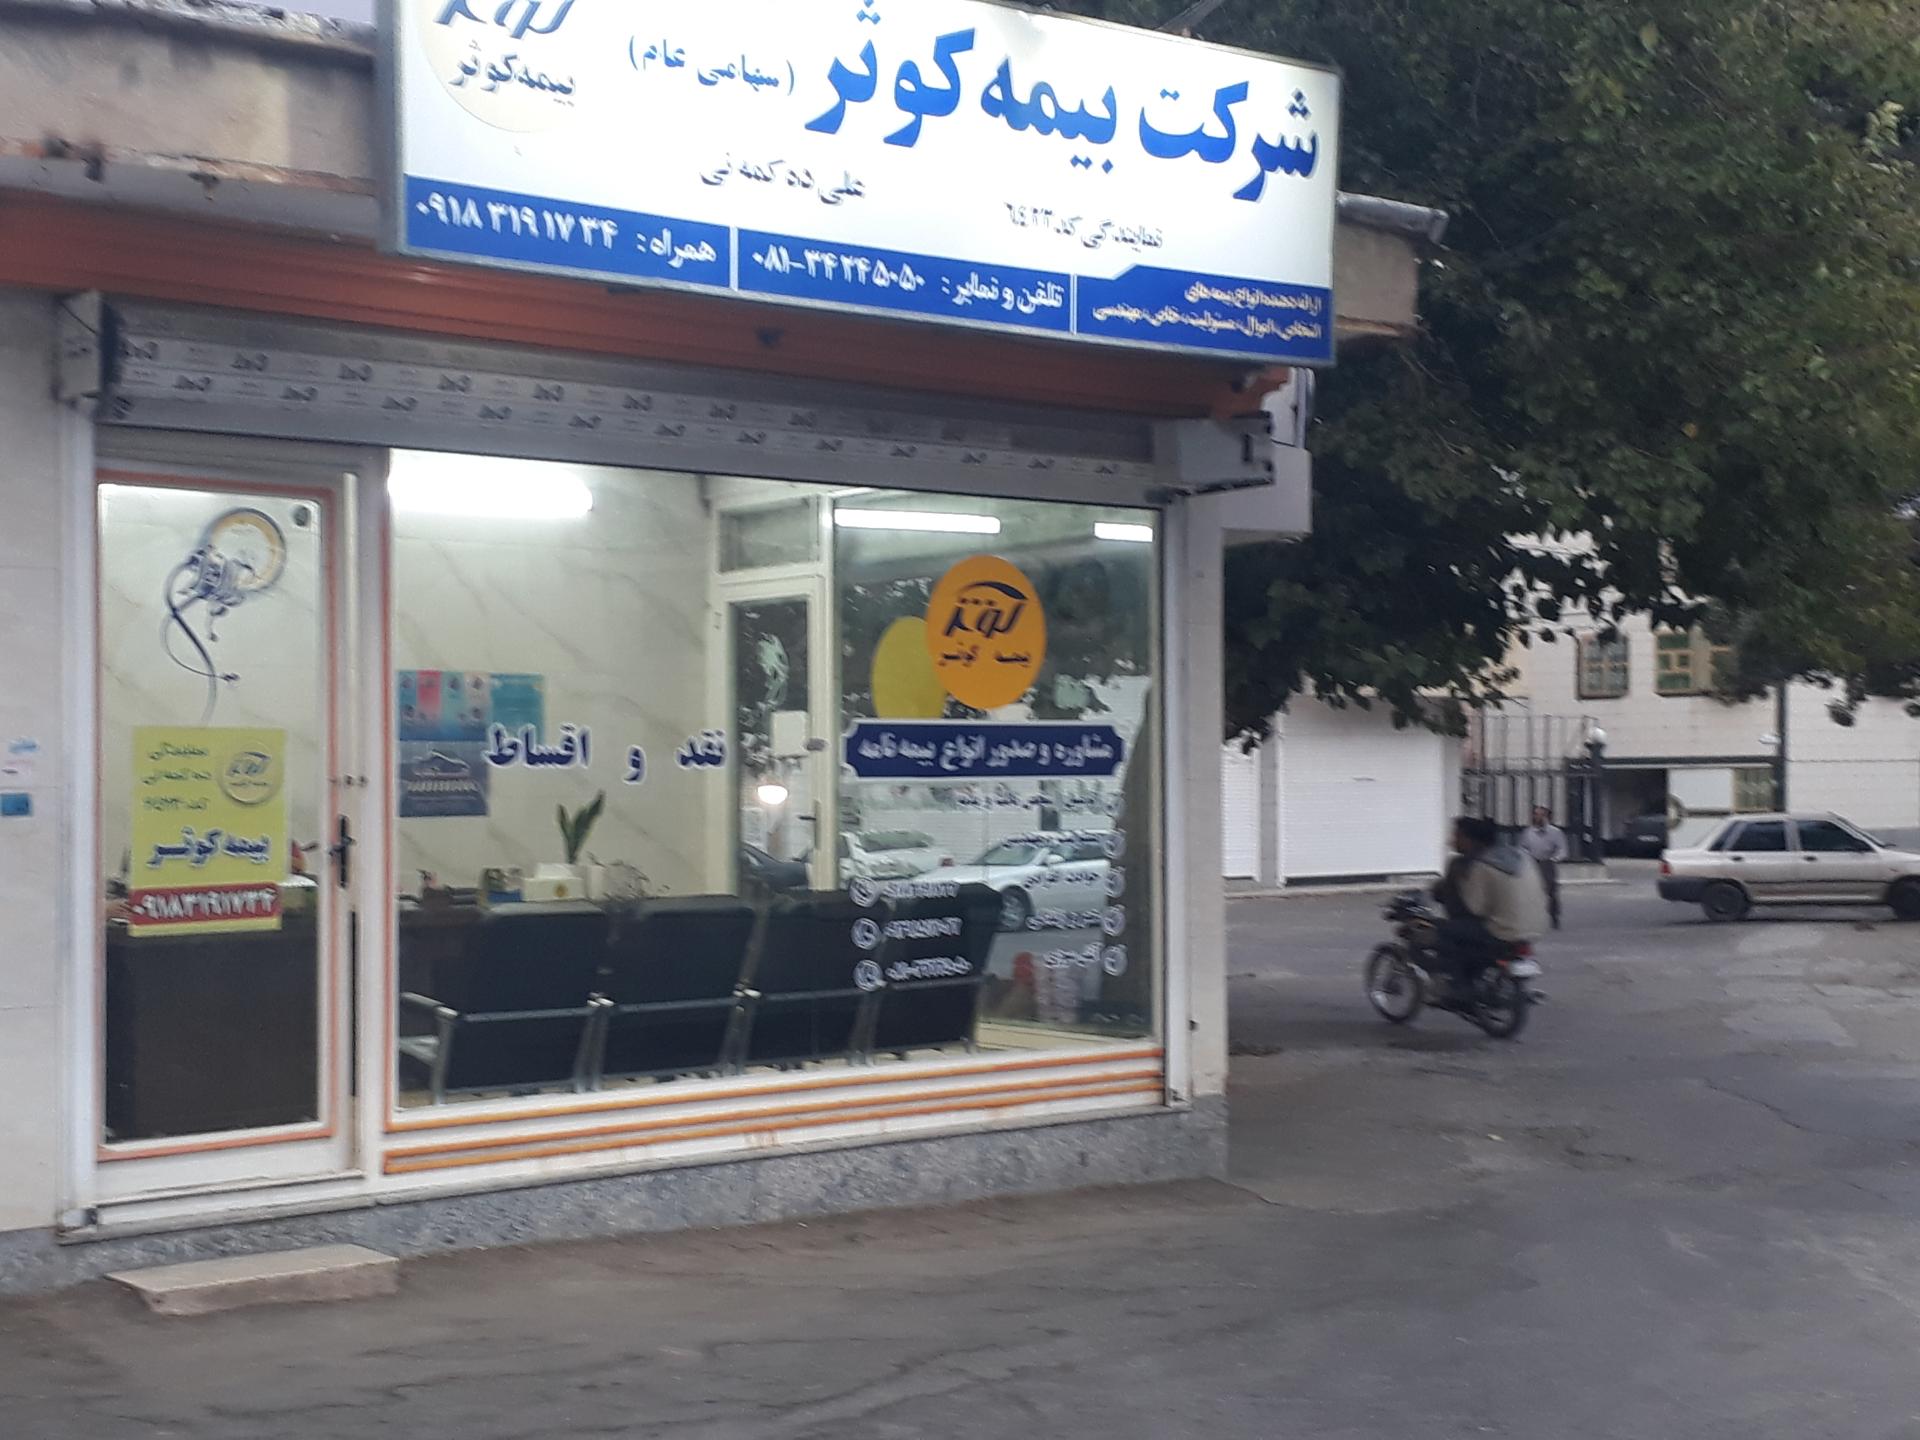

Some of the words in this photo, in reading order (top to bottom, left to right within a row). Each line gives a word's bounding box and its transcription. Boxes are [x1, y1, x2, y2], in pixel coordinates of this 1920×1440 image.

[804, 0, 975, 148] کوثر
[979, 54, 1117, 175] بیمه
[1139, 80, 1318, 202] شرکت
[817, 170, 866, 206] علی
[1001, 286, 1015, 311] و
[1015, 280, 1065, 314] تلفن
[480, 721, 592, 769] اقساط
[622, 745, 647, 785] و
[675, 727, 728, 770] نقد
[898, 739, 937, 767] بیمه
[939, 734, 987, 770] انواع
